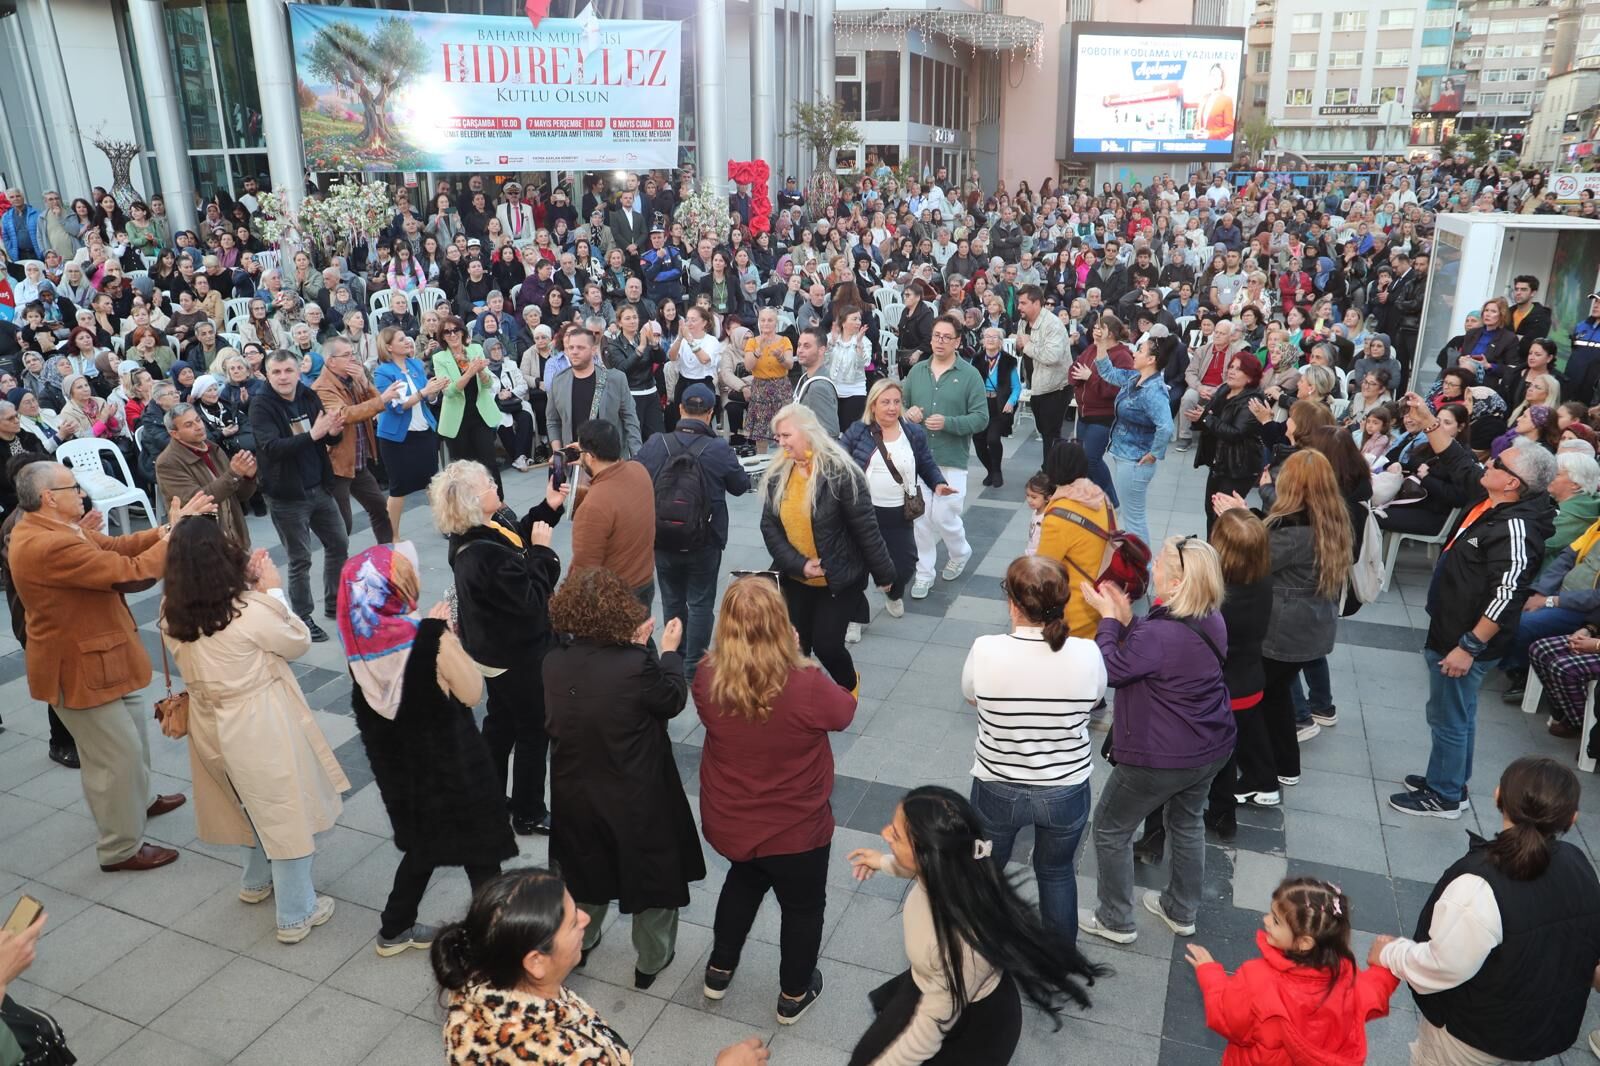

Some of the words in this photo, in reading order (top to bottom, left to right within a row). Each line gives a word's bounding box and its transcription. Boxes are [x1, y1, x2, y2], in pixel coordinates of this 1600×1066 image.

[478, 29, 542, 41] BAHARIN
[1124, 48, 1170, 58] KODLAMA
[1173, 49, 1183, 59] VE
[440, 43, 667, 87] HIDIRELLEZ
[497, 87, 549, 102] KUTLU
[556, 88, 609, 103] OLSUN
[501, 119, 518, 128] 18.00
[529, 120, 533, 128] 7
[534, 120, 552, 128] MAYIS
[553, 120, 582, 129] PERŞEMBE
[588, 120, 603, 128] 18.00
[612, 120, 616, 128] 8
[618, 120, 635, 128] MAYIS
[636, 120, 651, 128] CUMA
[657, 120, 672, 128] 18.00
[529, 130, 547, 138] YAHYA
[548, 130, 568, 138] KAPTAN
